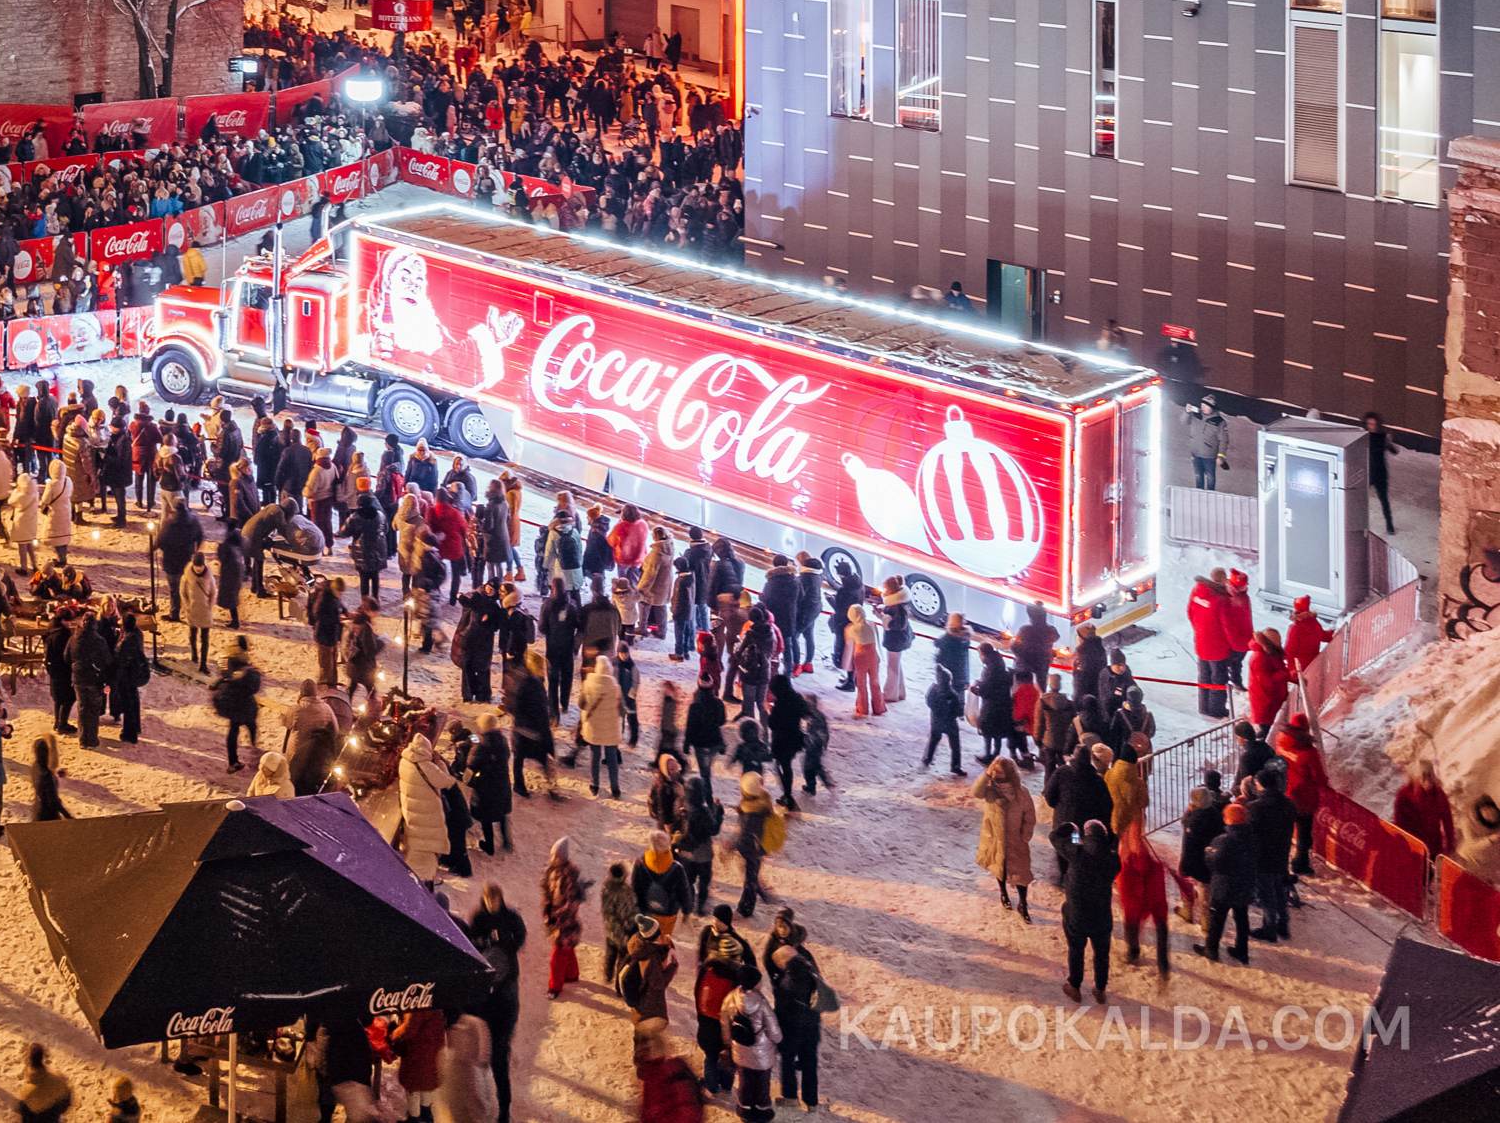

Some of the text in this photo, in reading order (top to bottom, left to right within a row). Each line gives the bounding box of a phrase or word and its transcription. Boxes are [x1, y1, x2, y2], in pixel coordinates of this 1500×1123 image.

[408, 157, 441, 181] Coca-Cola
[333, 171, 361, 195] Coca-Cola
[235, 199, 268, 225] Coca-Cola
[104, 231, 150, 258] Coca-Cola
[531, 314, 831, 484] Coca-Cola
[369, 982, 436, 1015] Coca-Cola
[166, 1006, 236, 1038] Coca-Cola
